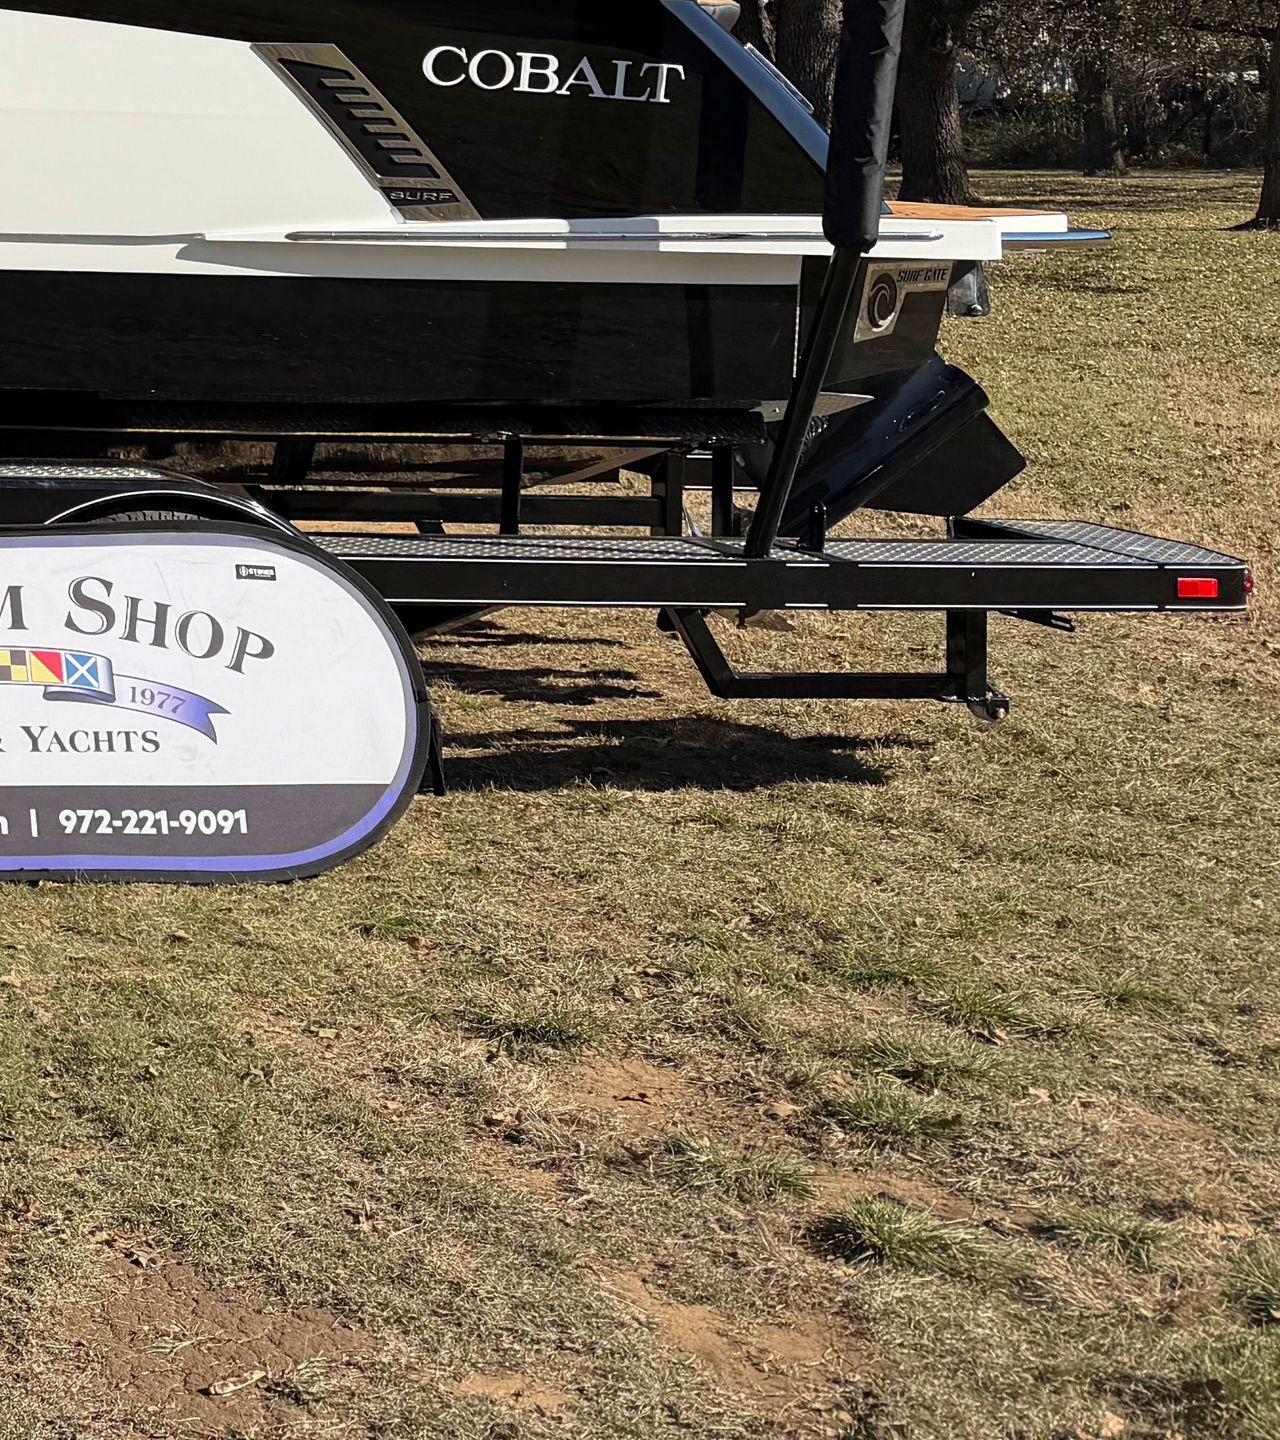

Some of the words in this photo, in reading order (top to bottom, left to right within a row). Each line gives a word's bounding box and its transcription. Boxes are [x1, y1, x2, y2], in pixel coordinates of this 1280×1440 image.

[422, 45, 685, 103] COBALT
[389, 191, 453, 201] SURF
[897, 269, 923, 282] SURF
[924, 268, 948, 281] GATE
[64, 575, 275, 675] SHOP
[129, 685, 188, 717] 1977
[20, 725, 161, 754] YACHTS
[58, 809, 249, 837] 972-221-9091
